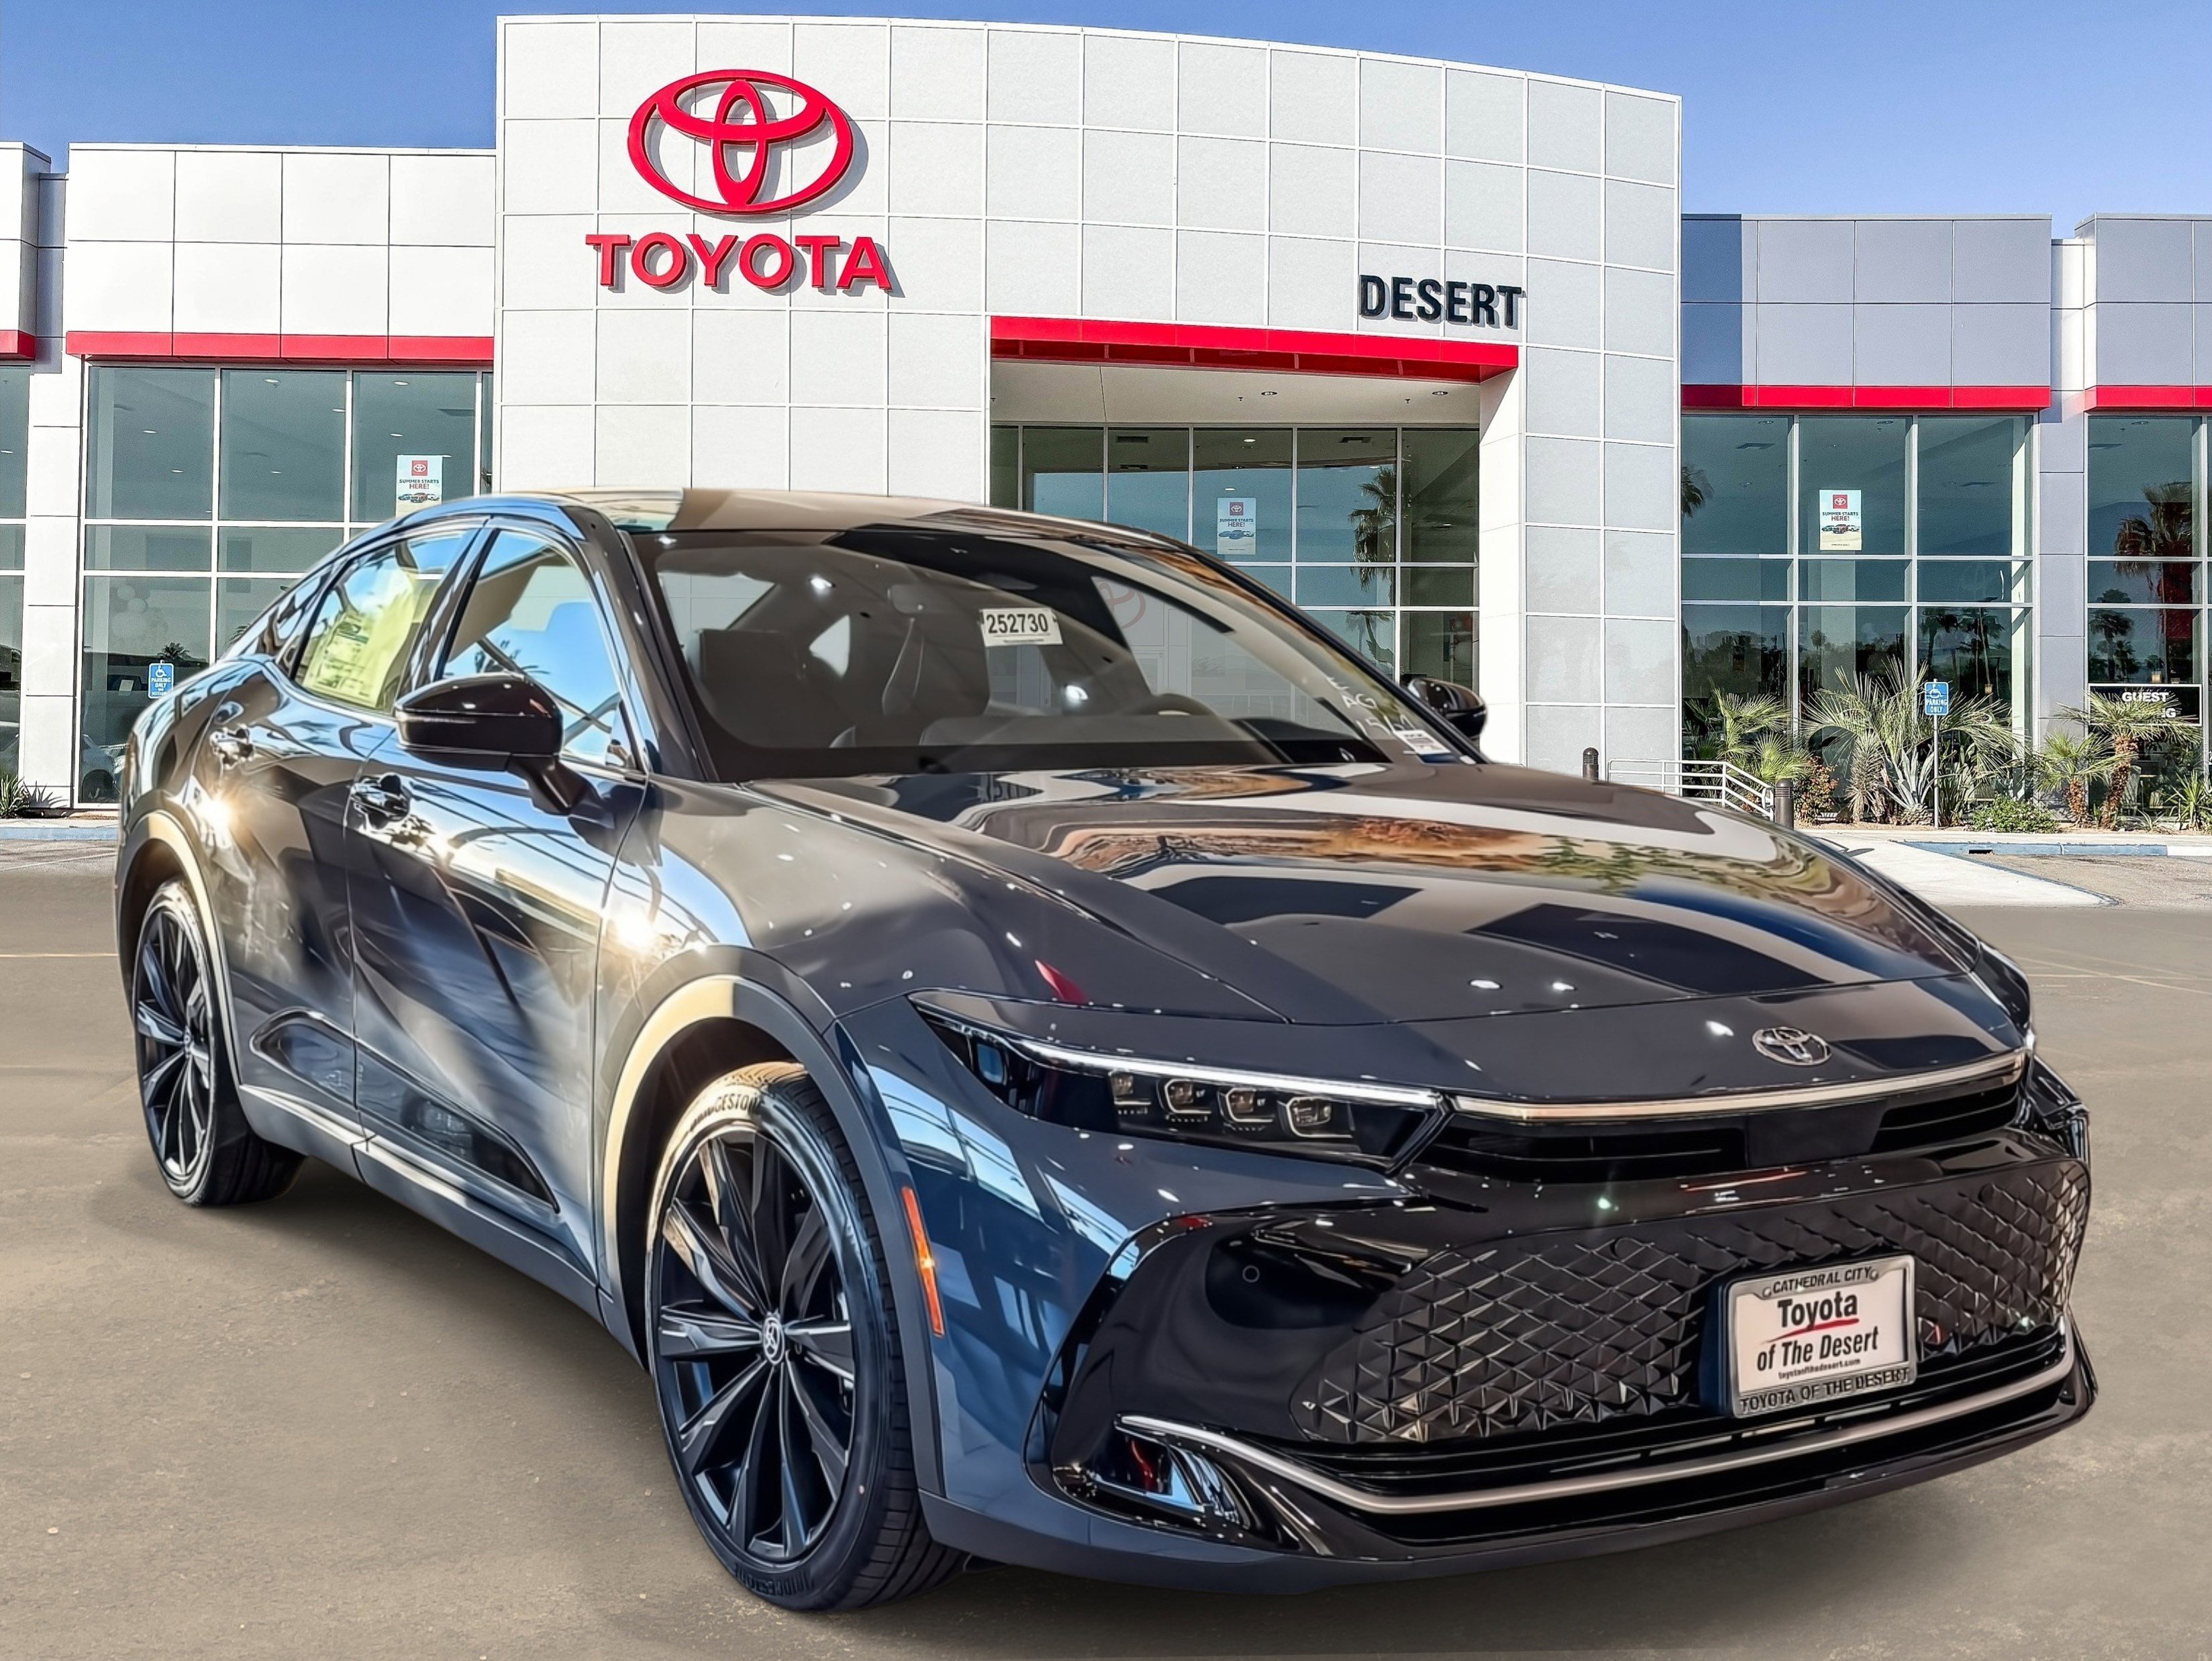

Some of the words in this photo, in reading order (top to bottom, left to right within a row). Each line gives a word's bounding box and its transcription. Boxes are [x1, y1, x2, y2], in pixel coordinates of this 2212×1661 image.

[585, 232, 892, 290] TOYOTA
[1359, 274, 1522, 326] DESERT
[987, 613, 1049, 634] 252730
[2121, 691, 2169, 702] GUEST
[1772, 1271, 1841, 1294] CATHEDRAL
[1844, 1266, 1873, 1282] CITY
[1776, 1291, 1858, 1330] Toyota
[1756, 1343, 1776, 1372] of
[1781, 1340, 1813, 1367] The
[1819, 1325, 1879, 1360] Desert
[1738, 1388, 1796, 1411] TOYOTA
[1800, 1384, 1821, 1400] OF
[1823, 1378, 1852, 1396] THE
[1855, 1366, 1910, 1389] DESERT
